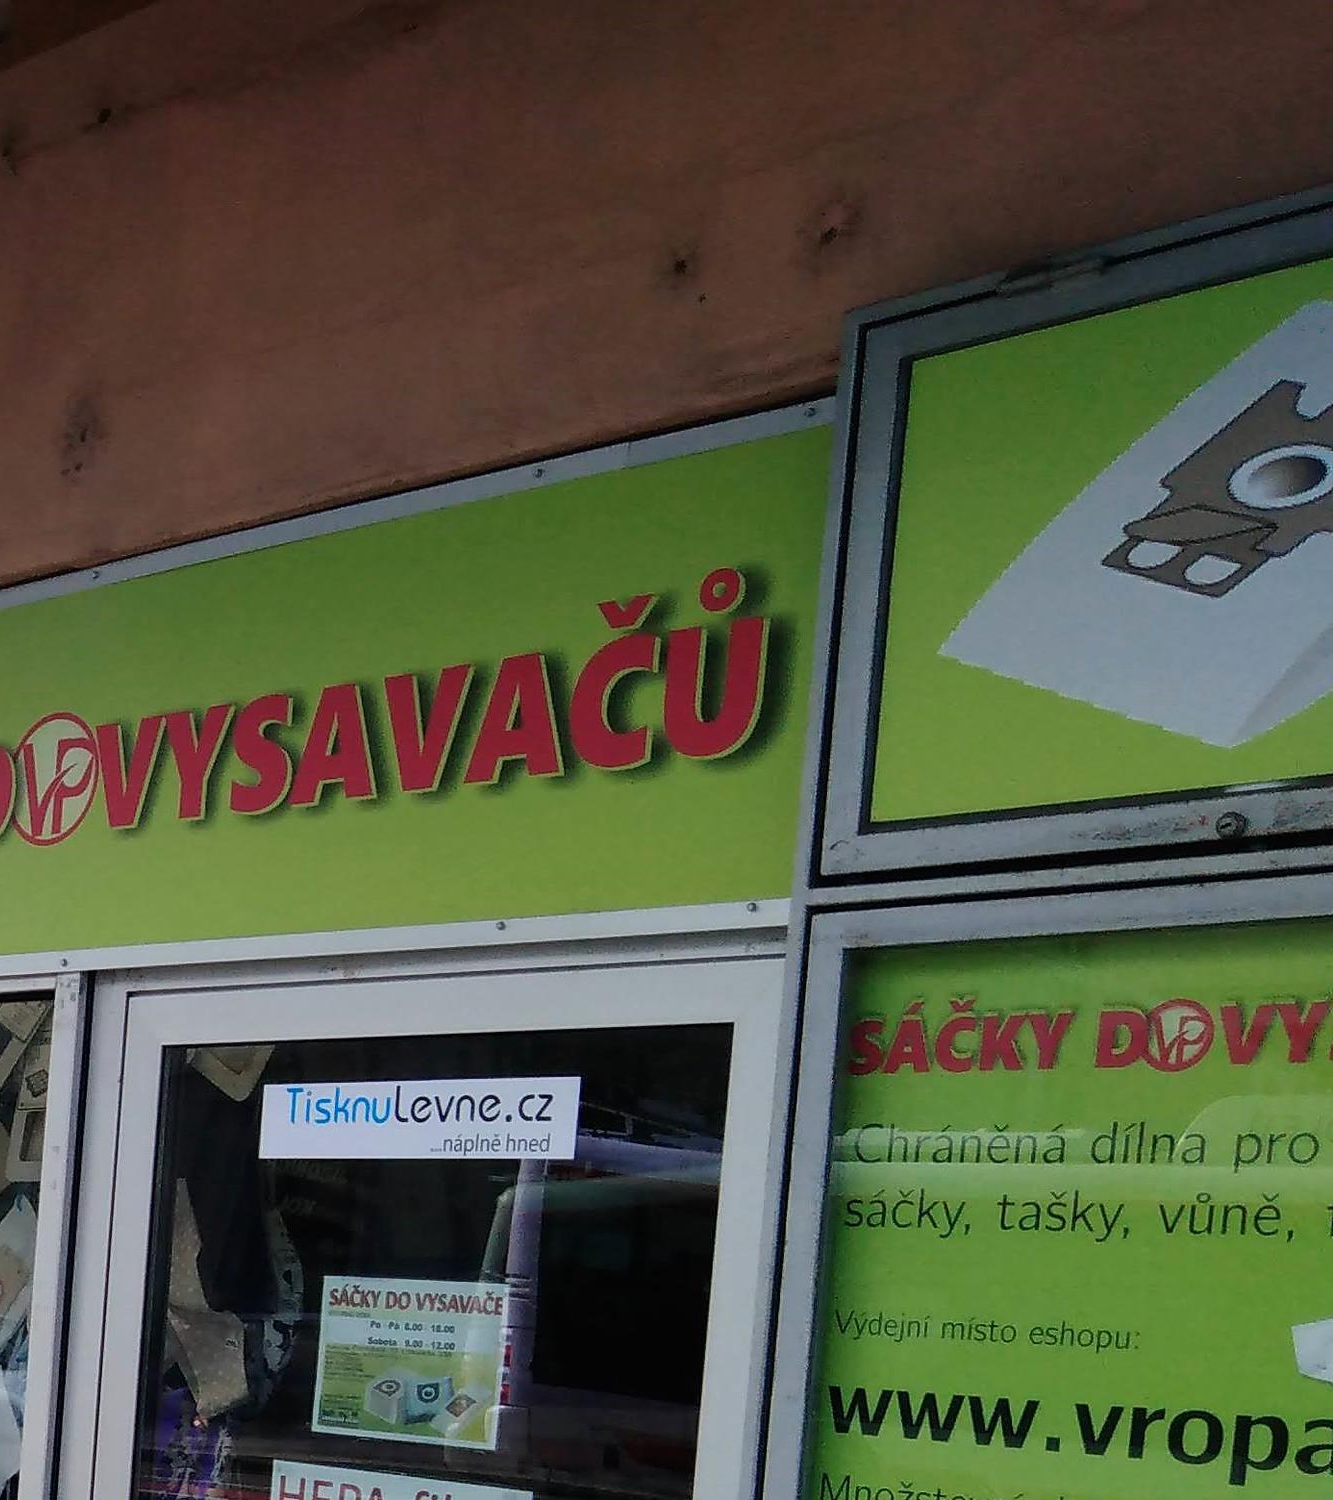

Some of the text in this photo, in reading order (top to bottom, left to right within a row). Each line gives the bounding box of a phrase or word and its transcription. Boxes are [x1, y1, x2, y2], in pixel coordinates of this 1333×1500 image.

[95, 568, 770, 833] VYSAVAČŮ
[847, 998, 1073, 1076] SÁČKY
[1220, 1000, 1333, 1065] VY
[505, 1133, 552, 1153] hned
[854, 1122, 1321, 1174] Chráněná dílna pro
[844, 1190, 972, 1238] sáčky,
[997, 1191, 1131, 1242] tašky,
[1159, 1194, 1295, 1243] vůně,
[329, 1283, 503, 1316] SÁČKY DO VYSAVAČE
[834, 1308, 1140, 1354] Výdejní místo eshopu:
